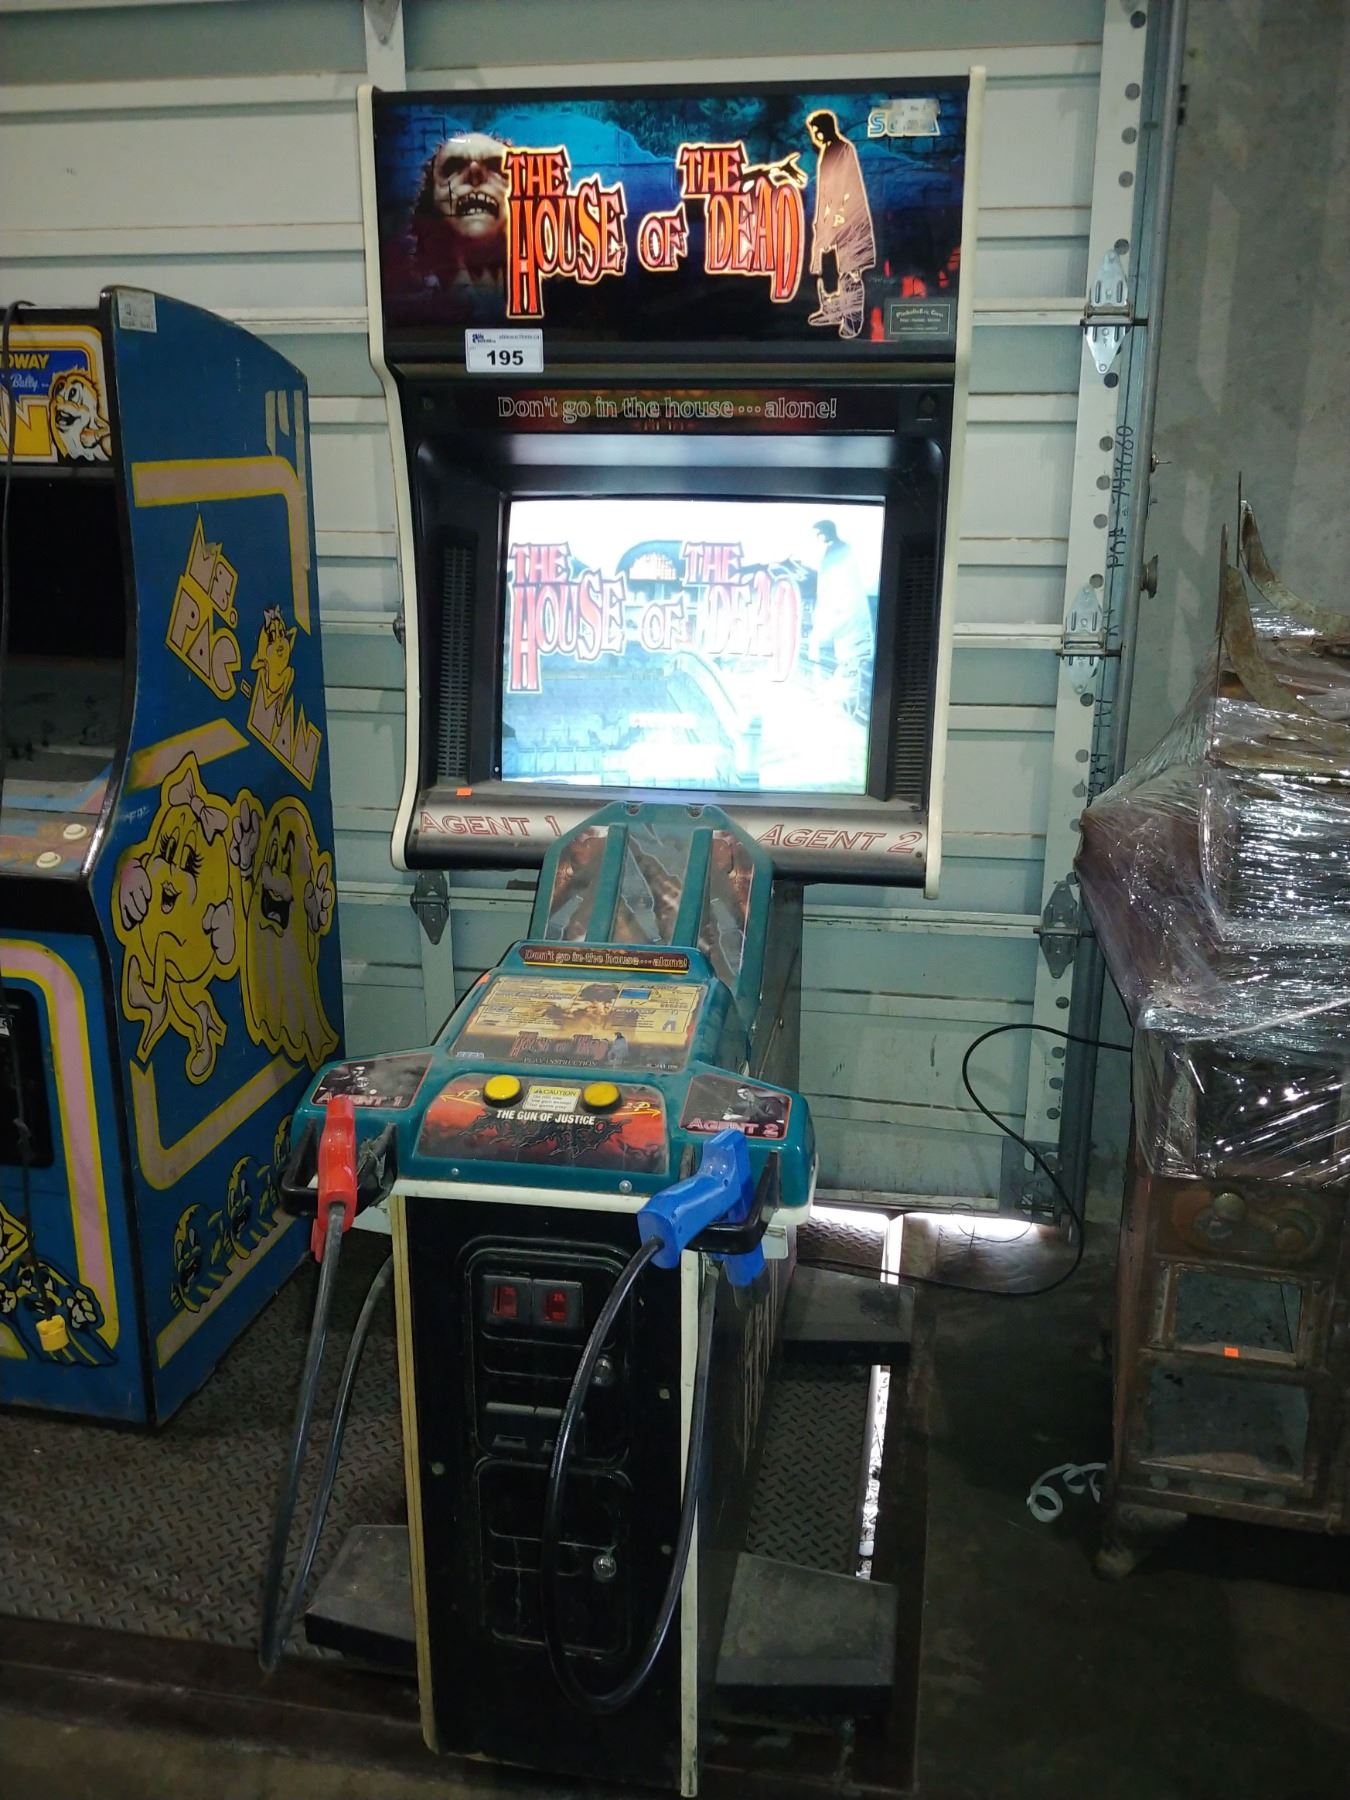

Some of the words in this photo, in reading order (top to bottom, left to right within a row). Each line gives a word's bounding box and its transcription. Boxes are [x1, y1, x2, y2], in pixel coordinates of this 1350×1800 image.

[504, 148, 570, 196] THE
[679, 142, 747, 194] THE
[508, 177, 626, 317] HOUSE
[639, 206, 688, 270] OF
[706, 176, 803, 300] DEAD
[486, 350, 524, 366] 195
[498, 396, 557, 417] Don't
[562, 402, 591, 424] go
[596, 397, 618, 417] in
[621, 397, 660, 417] the
[665, 397, 734, 418] house
[764, 397, 838, 418] alone!
[510, 542, 571, 585] THE
[683, 541, 744, 585] THE
[508, 568, 626, 693] HOUSE
[641, 591, 688, 650] OF
[420, 811, 530, 836] AGENT
[543, 815, 562, 837] 1
[756, 824, 888, 850] AGENT
[887, 831, 923, 854] 2
[525, 949, 554, 961] Don't
[556, 953, 571, 963] go
[605, 954, 640, 965] house
[496, 1109, 516, 1120] THE
[516, 1110, 539, 1121] GUN
[539, 1112, 554, 1122] OF
[554, 1113, 597, 1125] JUSTICE
[763, 1123, 780, 1137] 2
